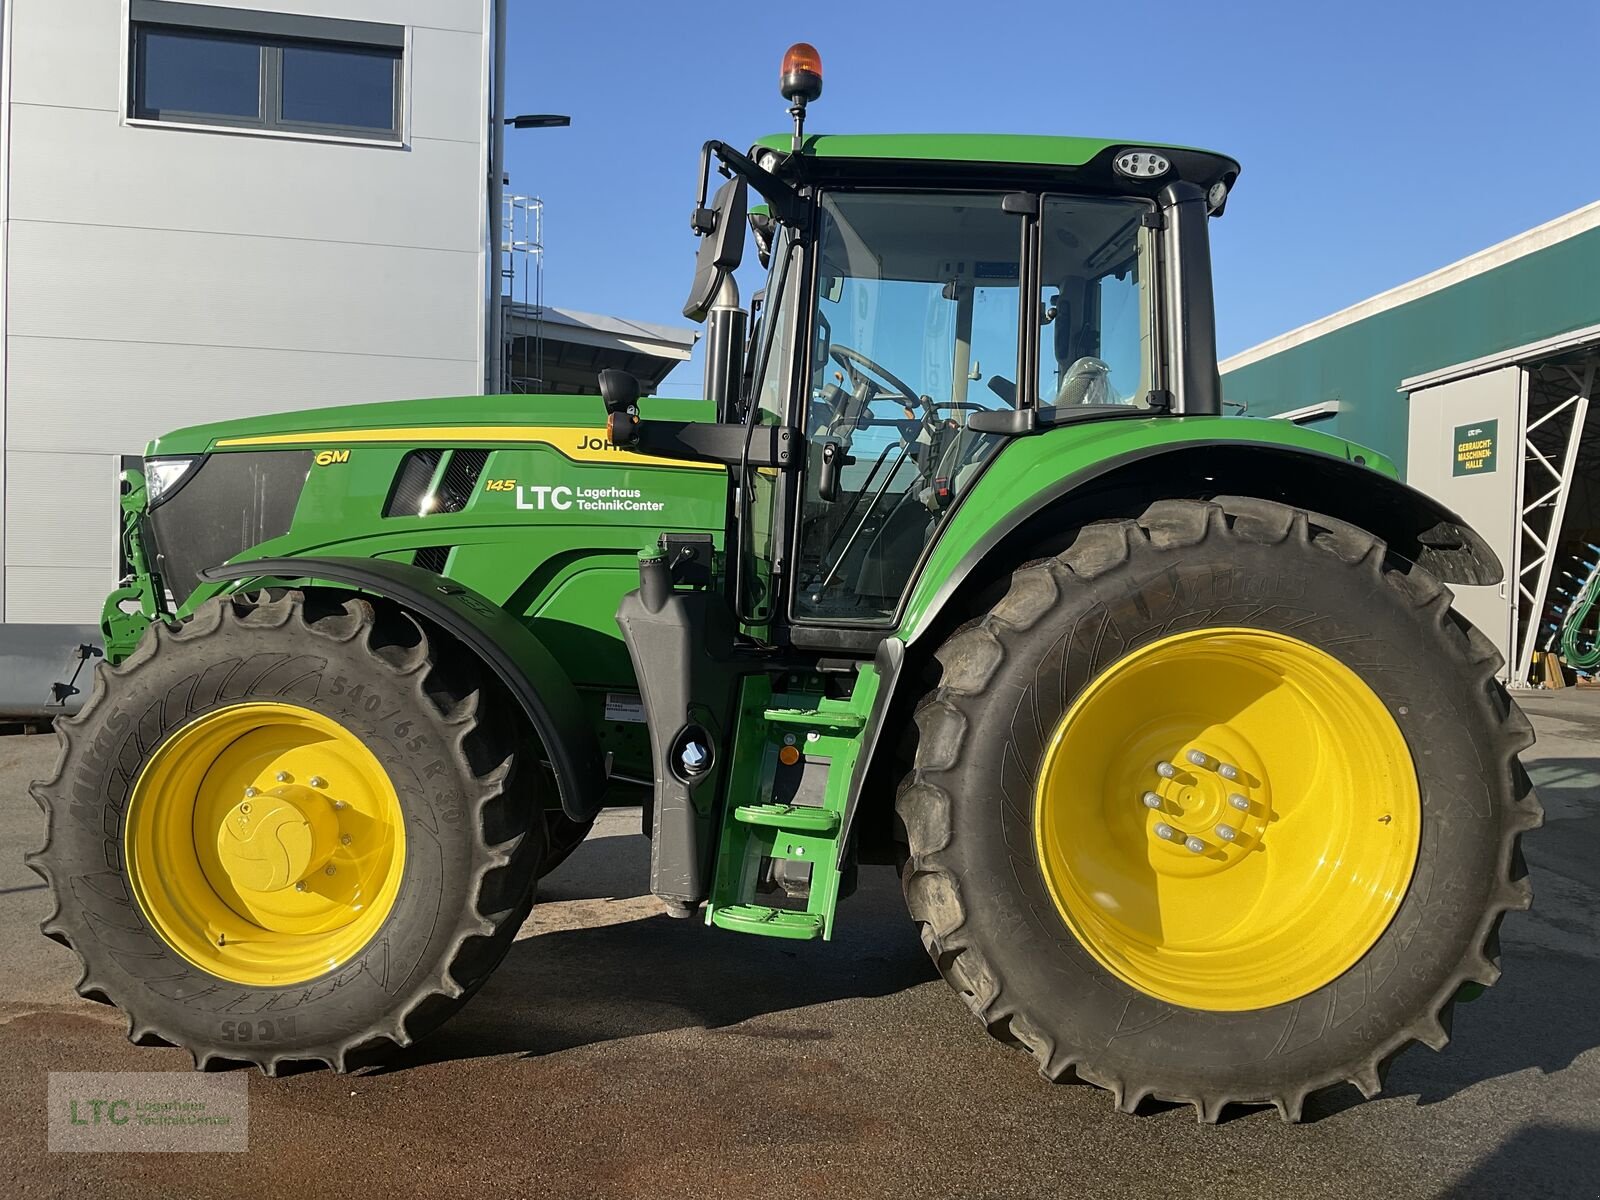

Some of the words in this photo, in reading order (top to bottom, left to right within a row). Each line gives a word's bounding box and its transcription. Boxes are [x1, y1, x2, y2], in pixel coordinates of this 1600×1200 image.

[577, 435, 623, 451] JOH
[1458, 439, 1492, 452] GEBRAUCHT-
[316, 449, 351, 466] 6M
[1457, 448, 1492, 461] MASCHINEN-
[1465, 459, 1483, 470] HALLE
[485, 479, 517, 491] 145
[516, 486, 573, 510] LTC
[576, 487, 641, 499] Lagerhaus
[576, 499, 665, 511] TechnikCenter
